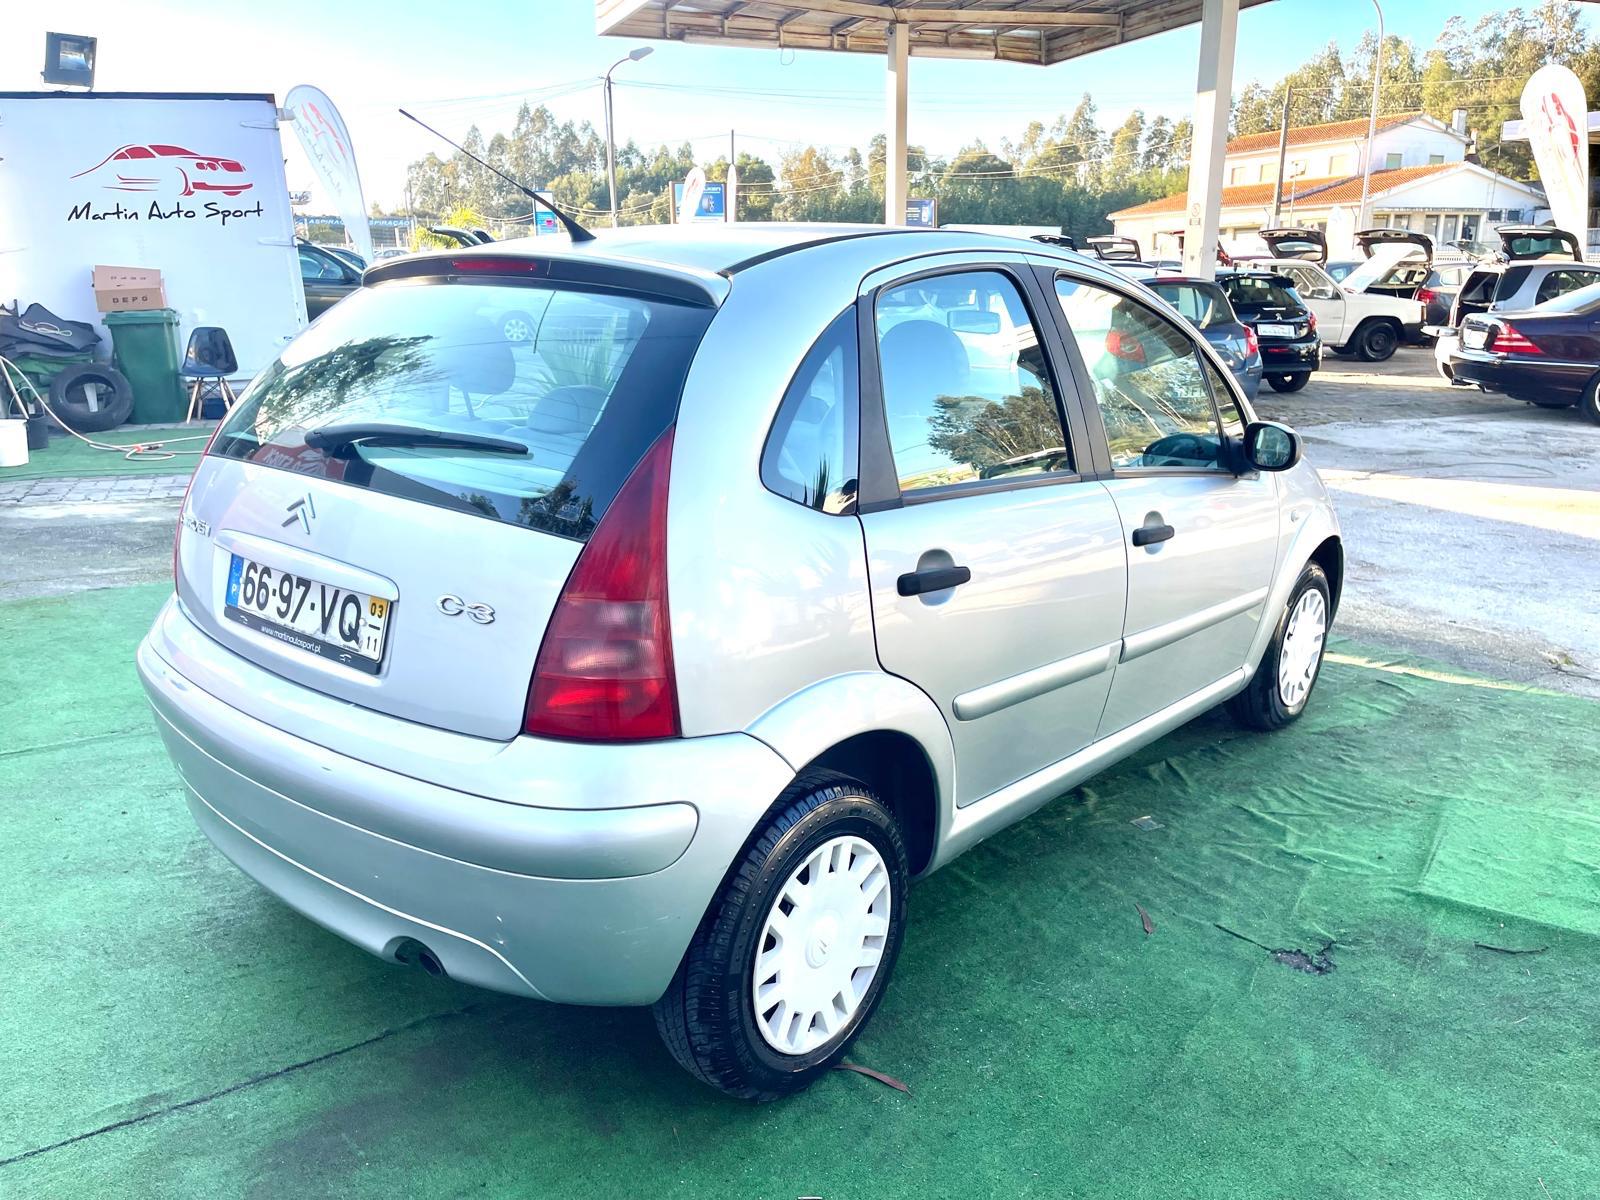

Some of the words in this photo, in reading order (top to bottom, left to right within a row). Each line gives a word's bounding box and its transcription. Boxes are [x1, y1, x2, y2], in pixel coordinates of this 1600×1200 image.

[67, 201, 139, 222] Martin
[148, 200, 196, 220] Auto
[204, 200, 264, 226] Sport
[369, 219, 410, 227] SPIRAÇÃO
[370, 602, 384, 619] 03
[366, 635, 378, 653] 11
